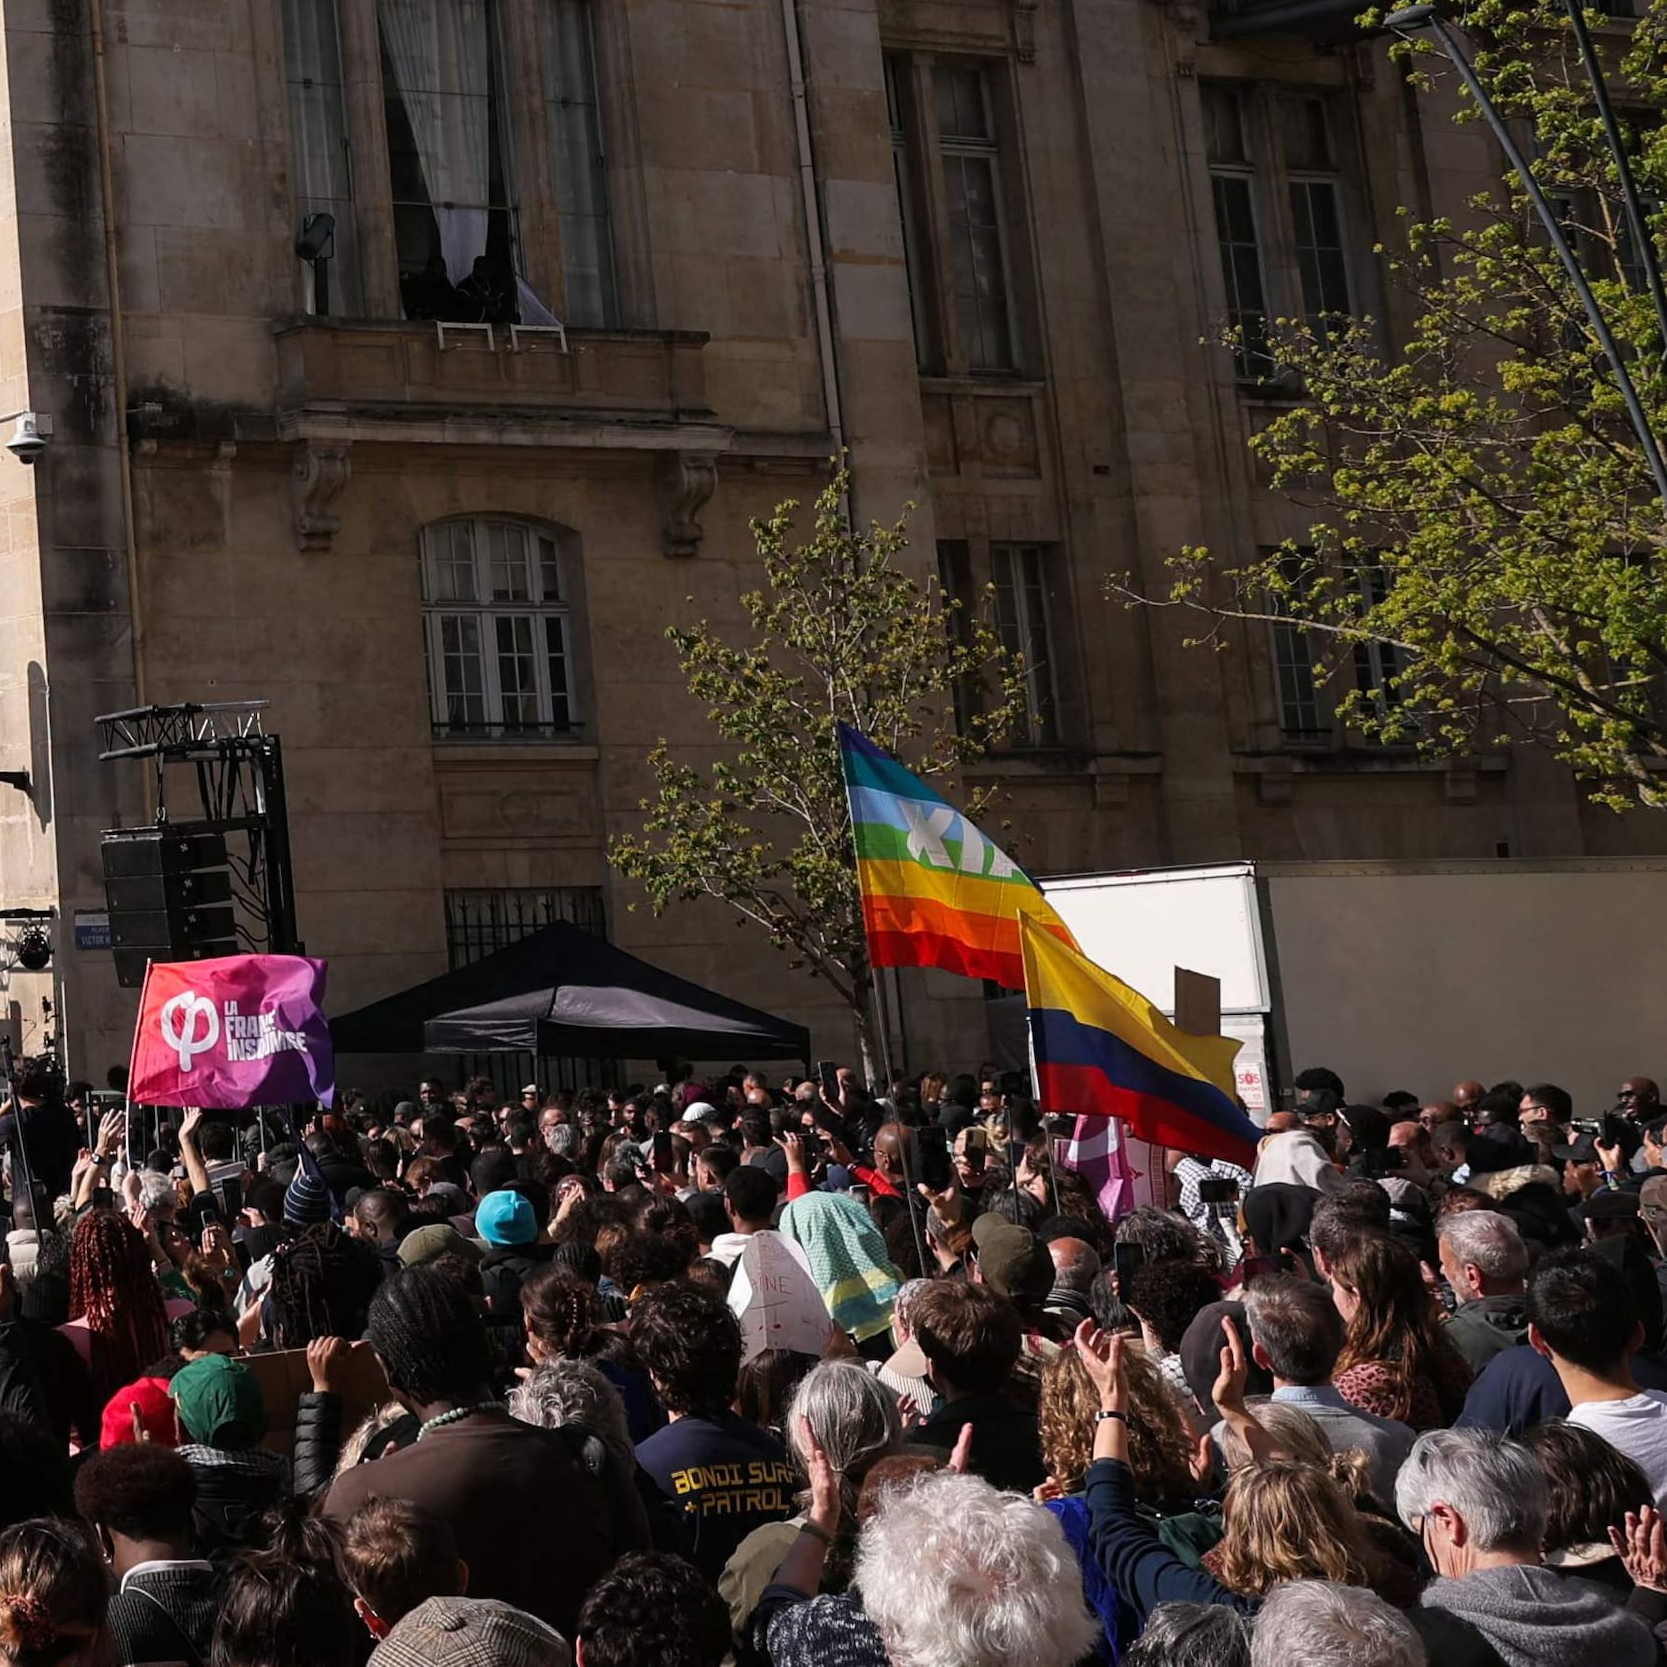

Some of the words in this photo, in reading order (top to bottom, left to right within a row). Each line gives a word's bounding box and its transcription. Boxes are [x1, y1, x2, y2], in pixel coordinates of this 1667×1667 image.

[223, 1000, 239, 1016] LA
[1237, 1072, 1261, 1085] SOS
[670, 1462, 744, 1495] BONDI
[700, 1487, 791, 1517] PATROL
